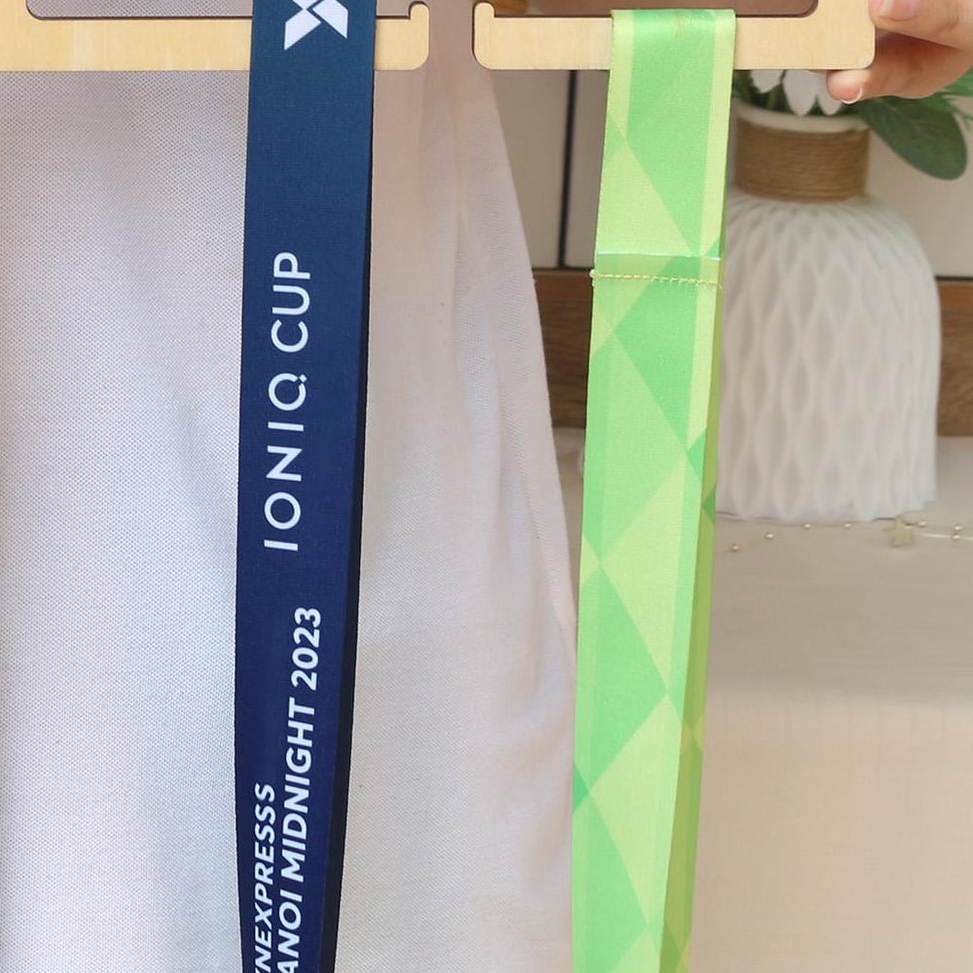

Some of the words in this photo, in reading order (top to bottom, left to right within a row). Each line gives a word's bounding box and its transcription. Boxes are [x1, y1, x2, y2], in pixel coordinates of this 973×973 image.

[270, 251, 311, 354] CUP
[263, 372, 308, 552] IONIQ
[290, 607, 322, 691] 2023
[254, 783, 276, 973] NEXPRESSS
[280, 696, 315, 883] MIDNIGHT
